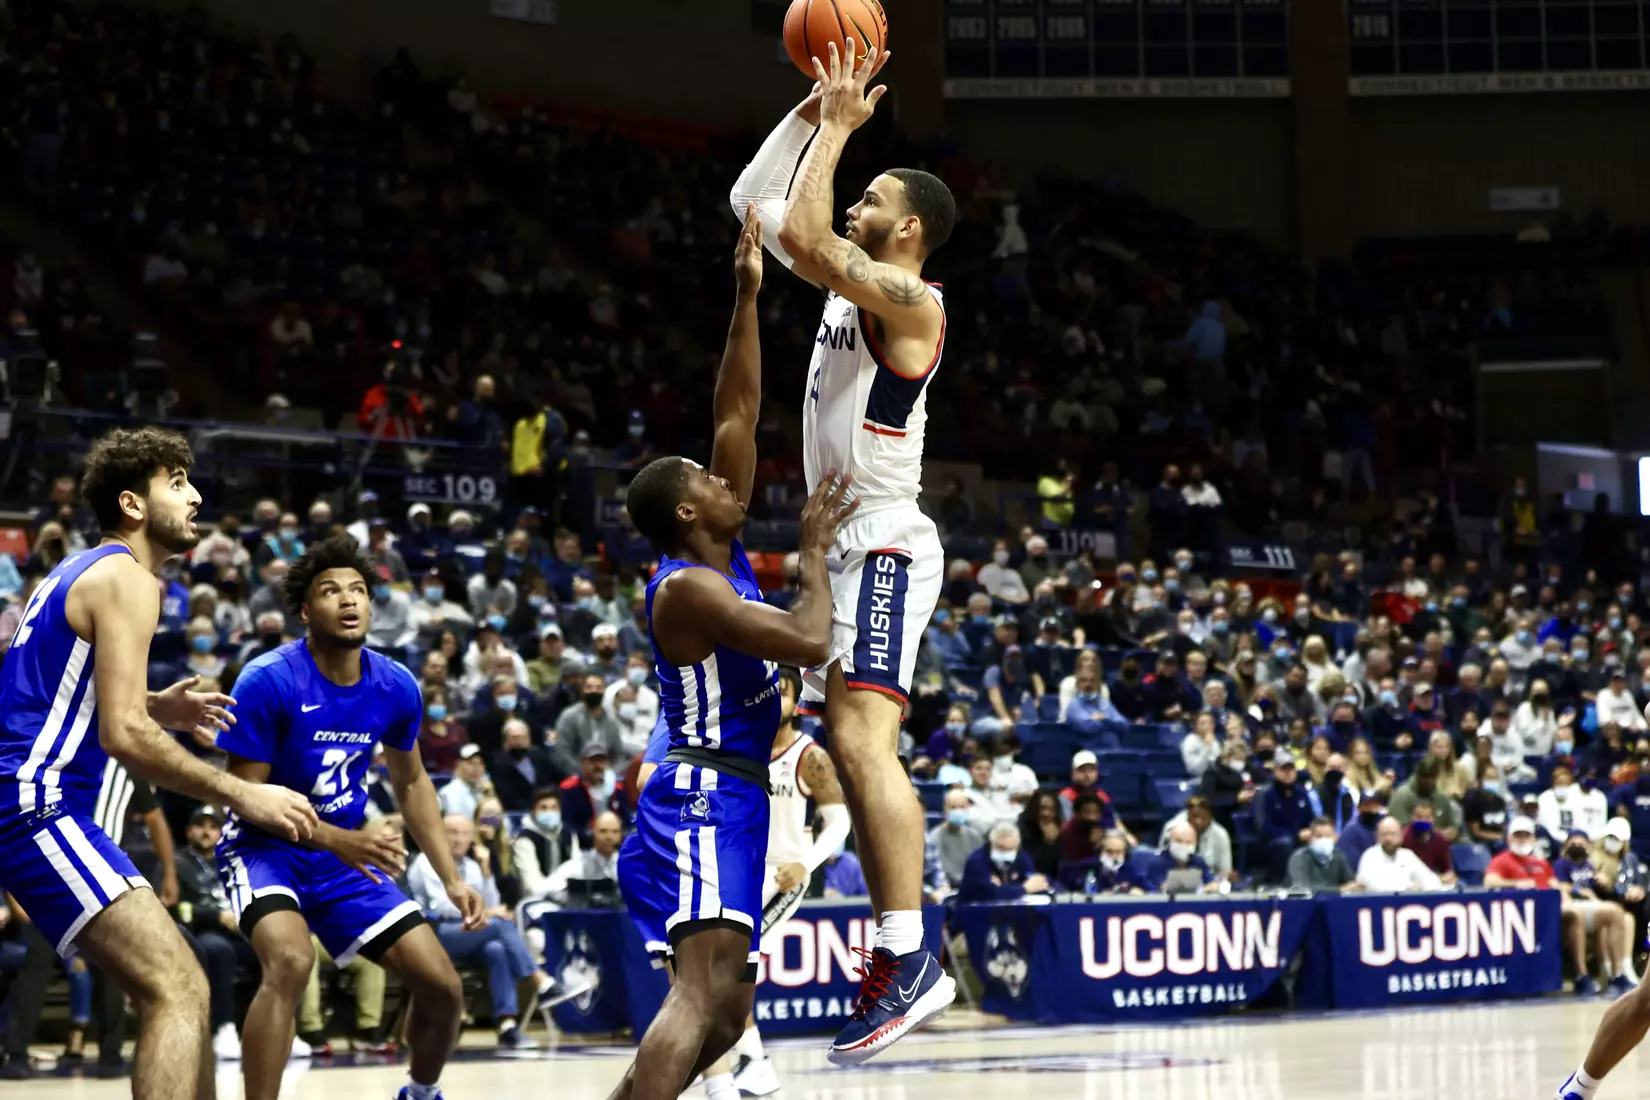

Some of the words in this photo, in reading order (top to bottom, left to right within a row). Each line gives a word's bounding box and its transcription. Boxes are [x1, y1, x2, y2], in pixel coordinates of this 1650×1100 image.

[404, 476, 439, 495] SEC
[442, 473, 497, 503] 109
[1263, 545, 1297, 570] 111
[869, 555, 897, 671] HUSKIES
[313, 730, 373, 751] CENTRAL
[310, 749, 364, 797] 21
[1079, 911, 1282, 980] UCONN
[1358, 898, 1537, 967] UCONN
[1112, 982, 1248, 1008] BASKETBALL
[1388, 966, 1508, 994] BASKETBALL
